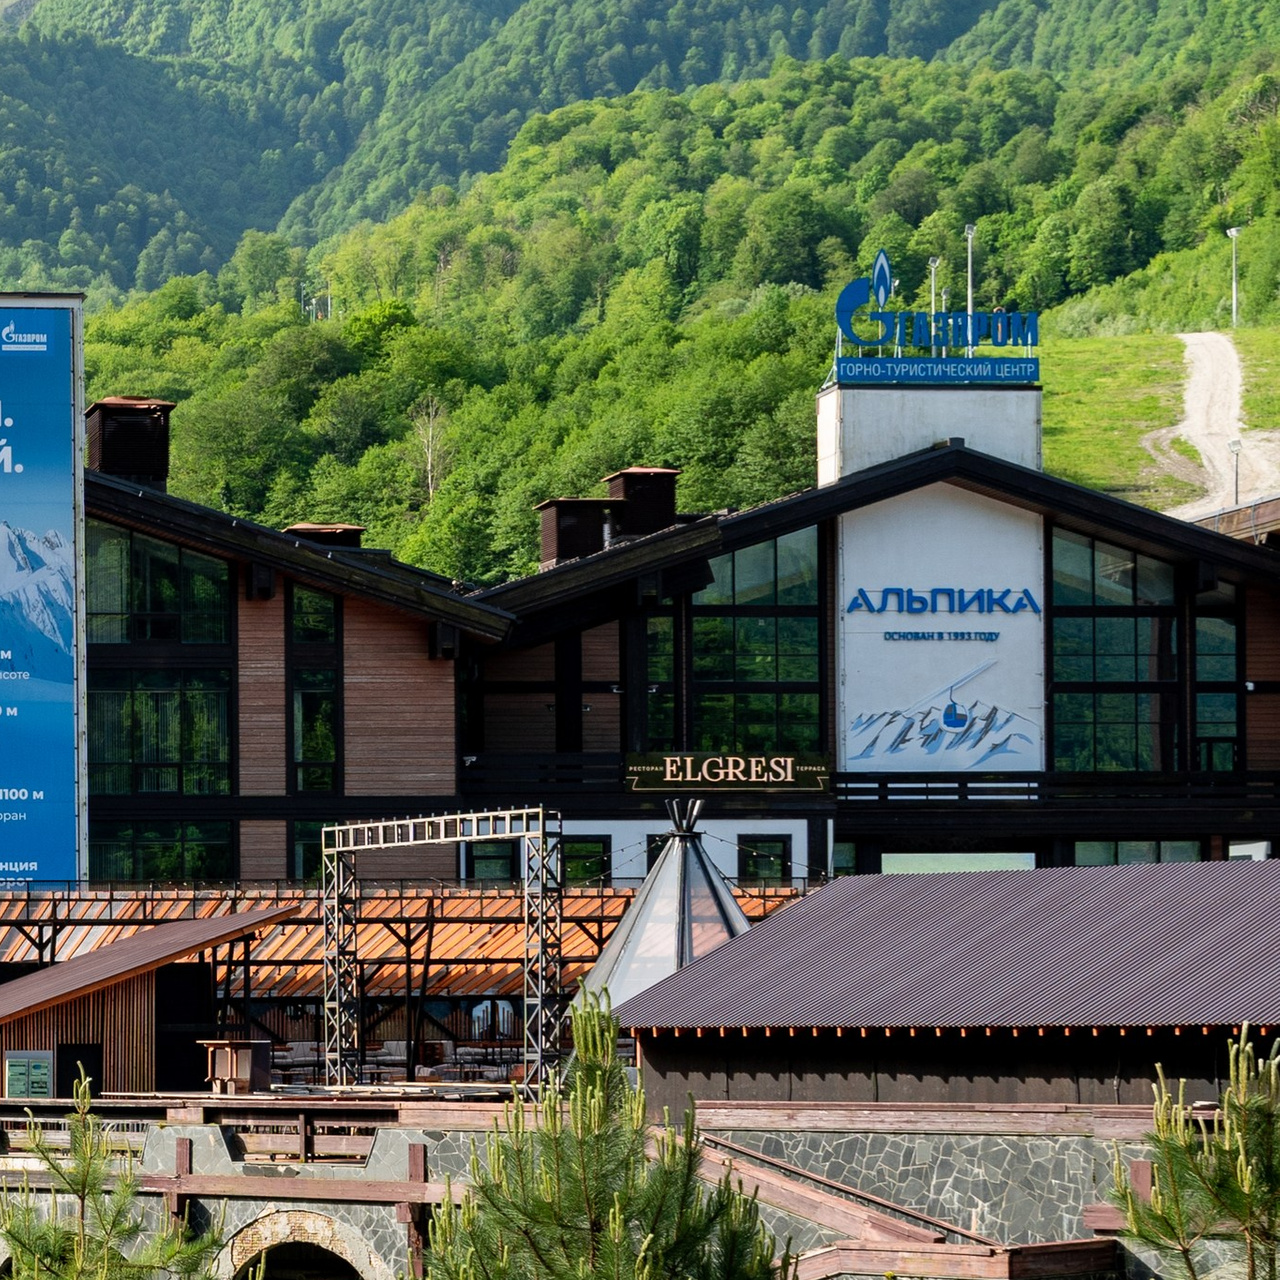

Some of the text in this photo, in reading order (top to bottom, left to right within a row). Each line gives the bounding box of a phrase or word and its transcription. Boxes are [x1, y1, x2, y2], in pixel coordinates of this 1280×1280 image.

[897, 311, 1039, 347] ГАЗПРОМ
[840, 361, 1035, 378] ГОРНО-ТУРИСТИЧЕСКИЙ ЦЕНТР
[846, 587, 1042, 614] АЛЬПИКА
[884, 631, 1000, 642] ОСНОВАН В 1993 ГОДУ
[0, 649, 12, 660] м
[6, 706, 18, 717] м
[663, 755, 796, 783] ELGRESI
[32, 790, 44, 800] м
